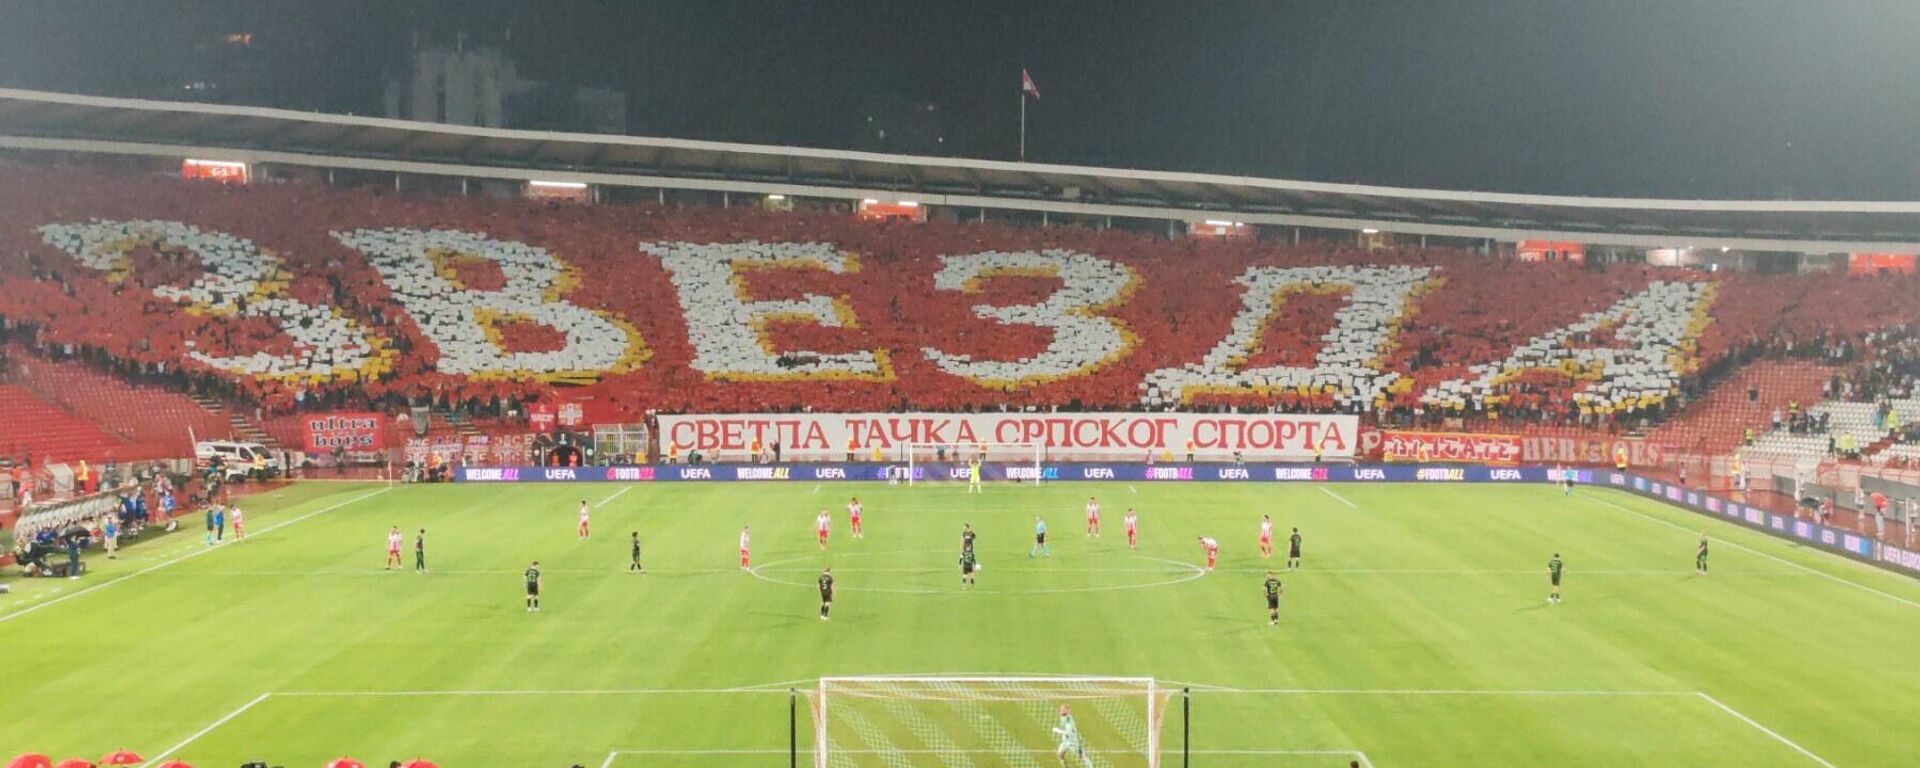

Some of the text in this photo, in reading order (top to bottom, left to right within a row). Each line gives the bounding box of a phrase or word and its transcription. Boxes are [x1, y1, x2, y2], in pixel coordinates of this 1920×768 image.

[38, 217, 1717, 411] ЗВЕЗДА
[845, 419, 979, 450] ТАЧКА
[994, 418, 1179, 450] СРПСКОГ
[1192, 418, 1347, 450] СПОРТА
[546, 469, 576, 480] UEFA
[681, 469, 711, 480] UEFA
[816, 468, 846, 480] UEFA
[1084, 468, 1114, 480] UEFA
[1219, 469, 1249, 480] UEFA
[1355, 469, 1385, 480] UEFA
[1490, 470, 1521, 481] UEFA
